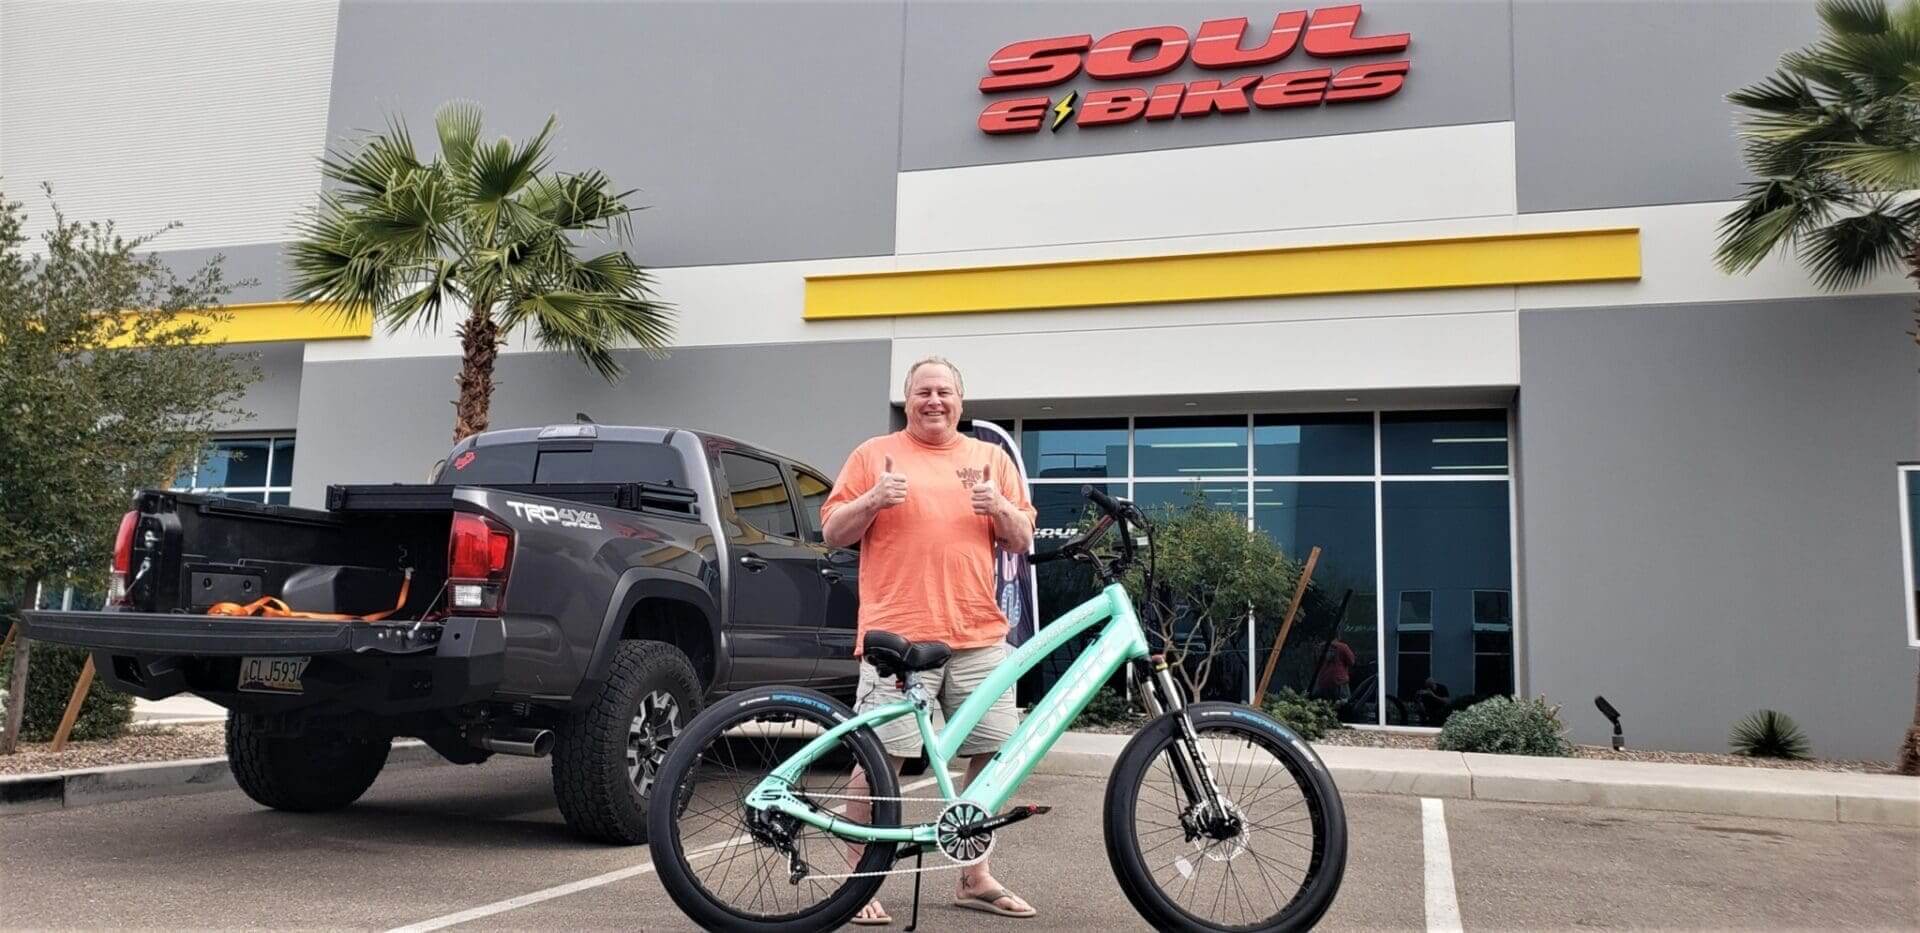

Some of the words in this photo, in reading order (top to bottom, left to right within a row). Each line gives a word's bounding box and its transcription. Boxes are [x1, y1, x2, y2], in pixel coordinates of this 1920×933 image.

[979, 4, 1411, 93] SOUL
[1076, 60, 1411, 128] BIKES
[506, 501, 559, 525] TRD
